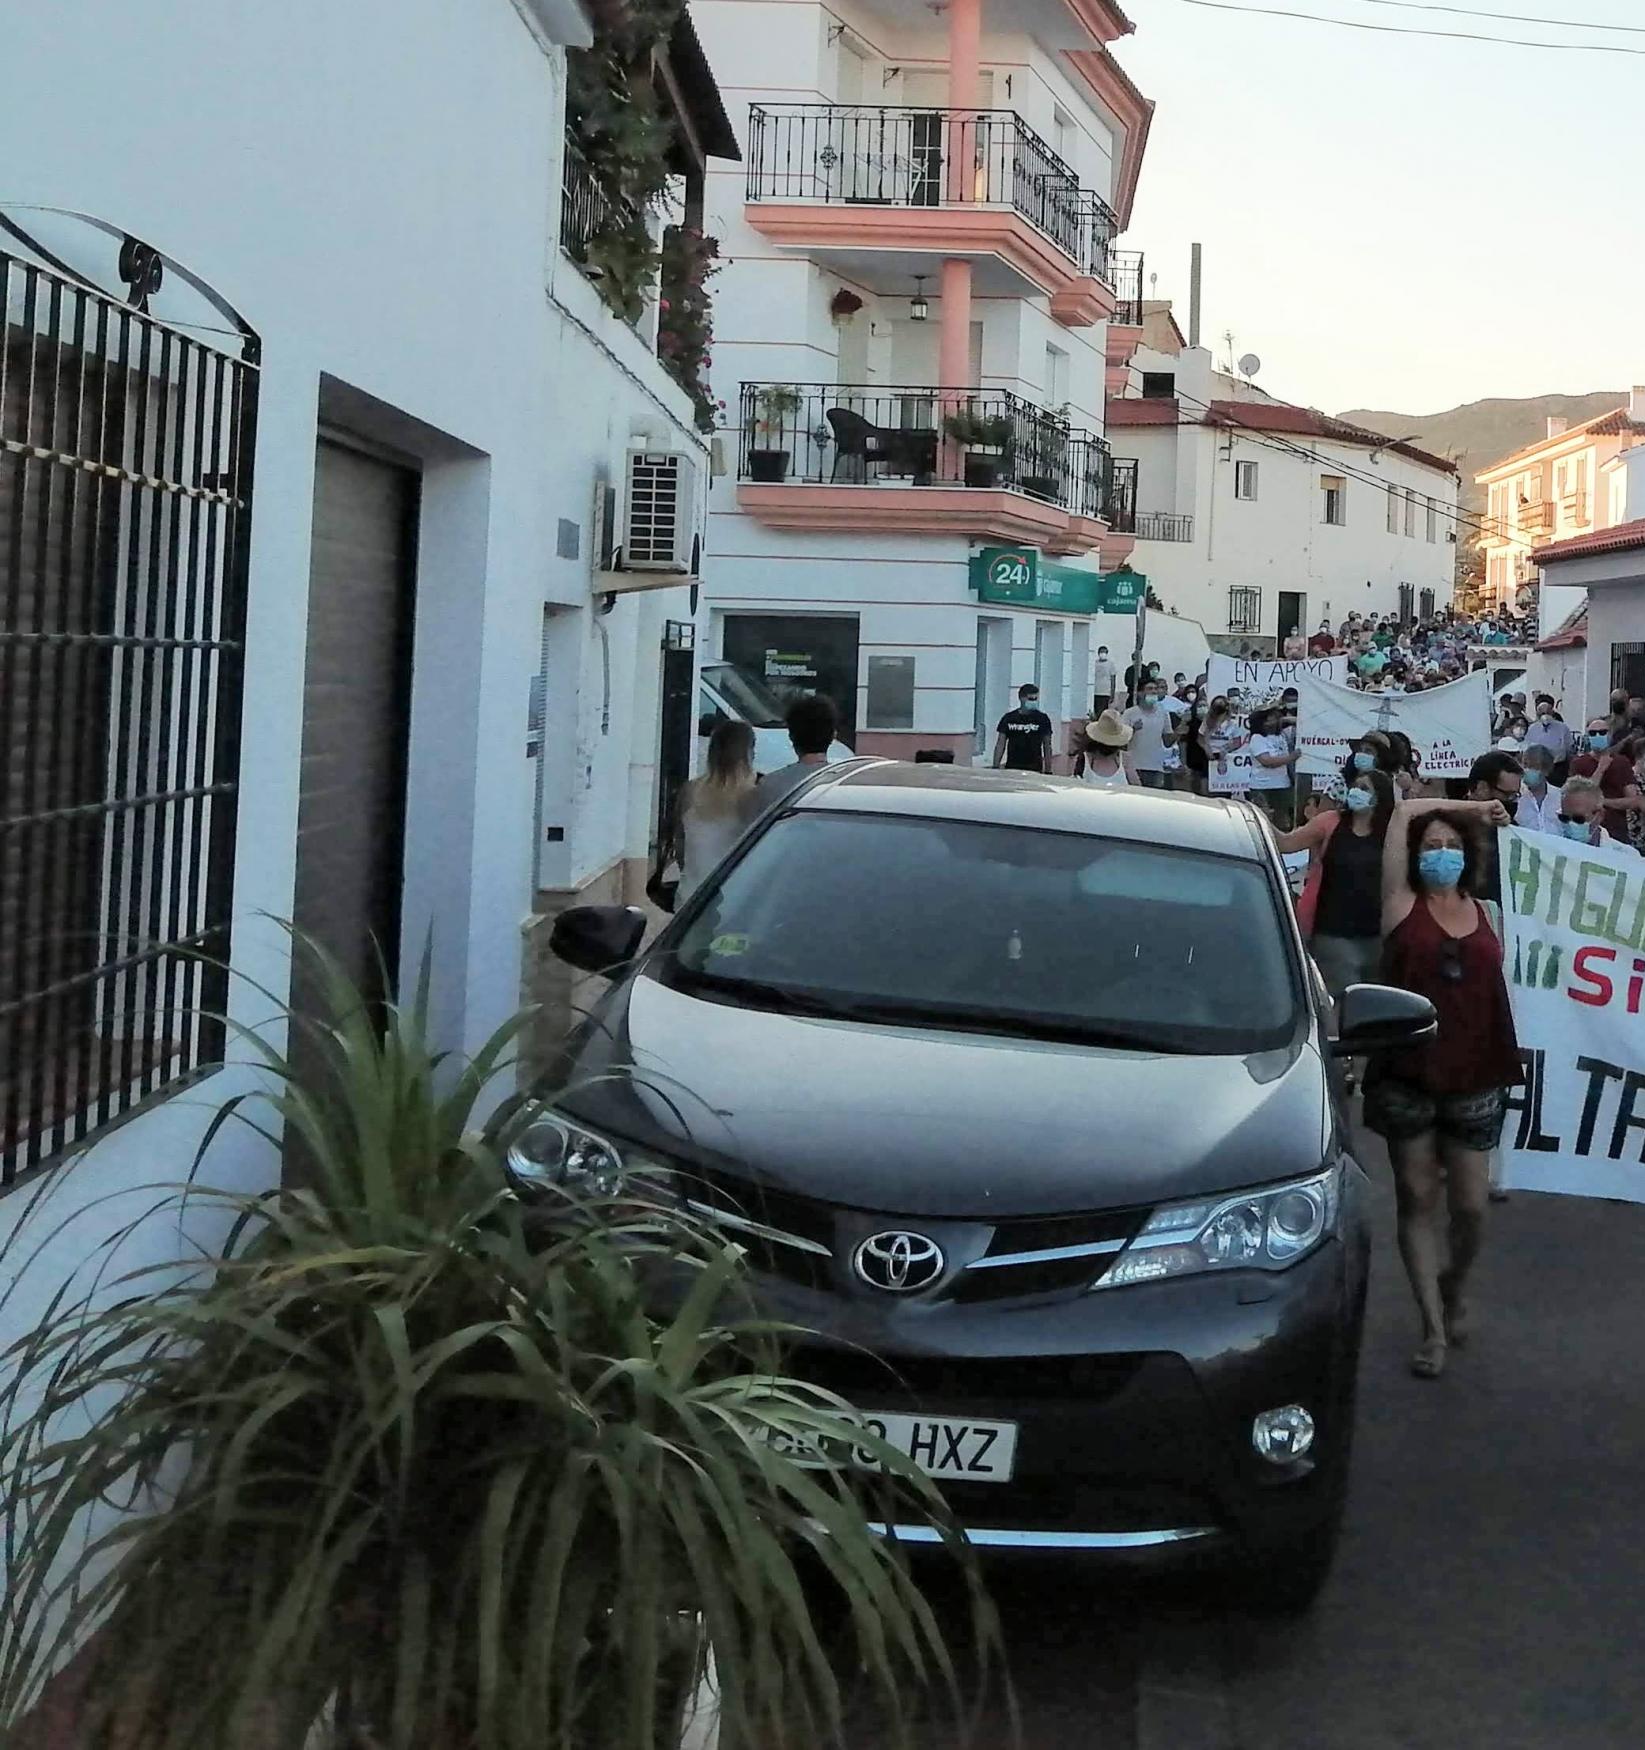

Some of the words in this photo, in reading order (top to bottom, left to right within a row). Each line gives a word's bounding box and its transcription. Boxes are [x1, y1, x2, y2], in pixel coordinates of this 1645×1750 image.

[1235, 661, 1258, 683] EN
[1008, 723, 1040, 734] Wrangler
[909, 1422, 999, 1473] HXZ
